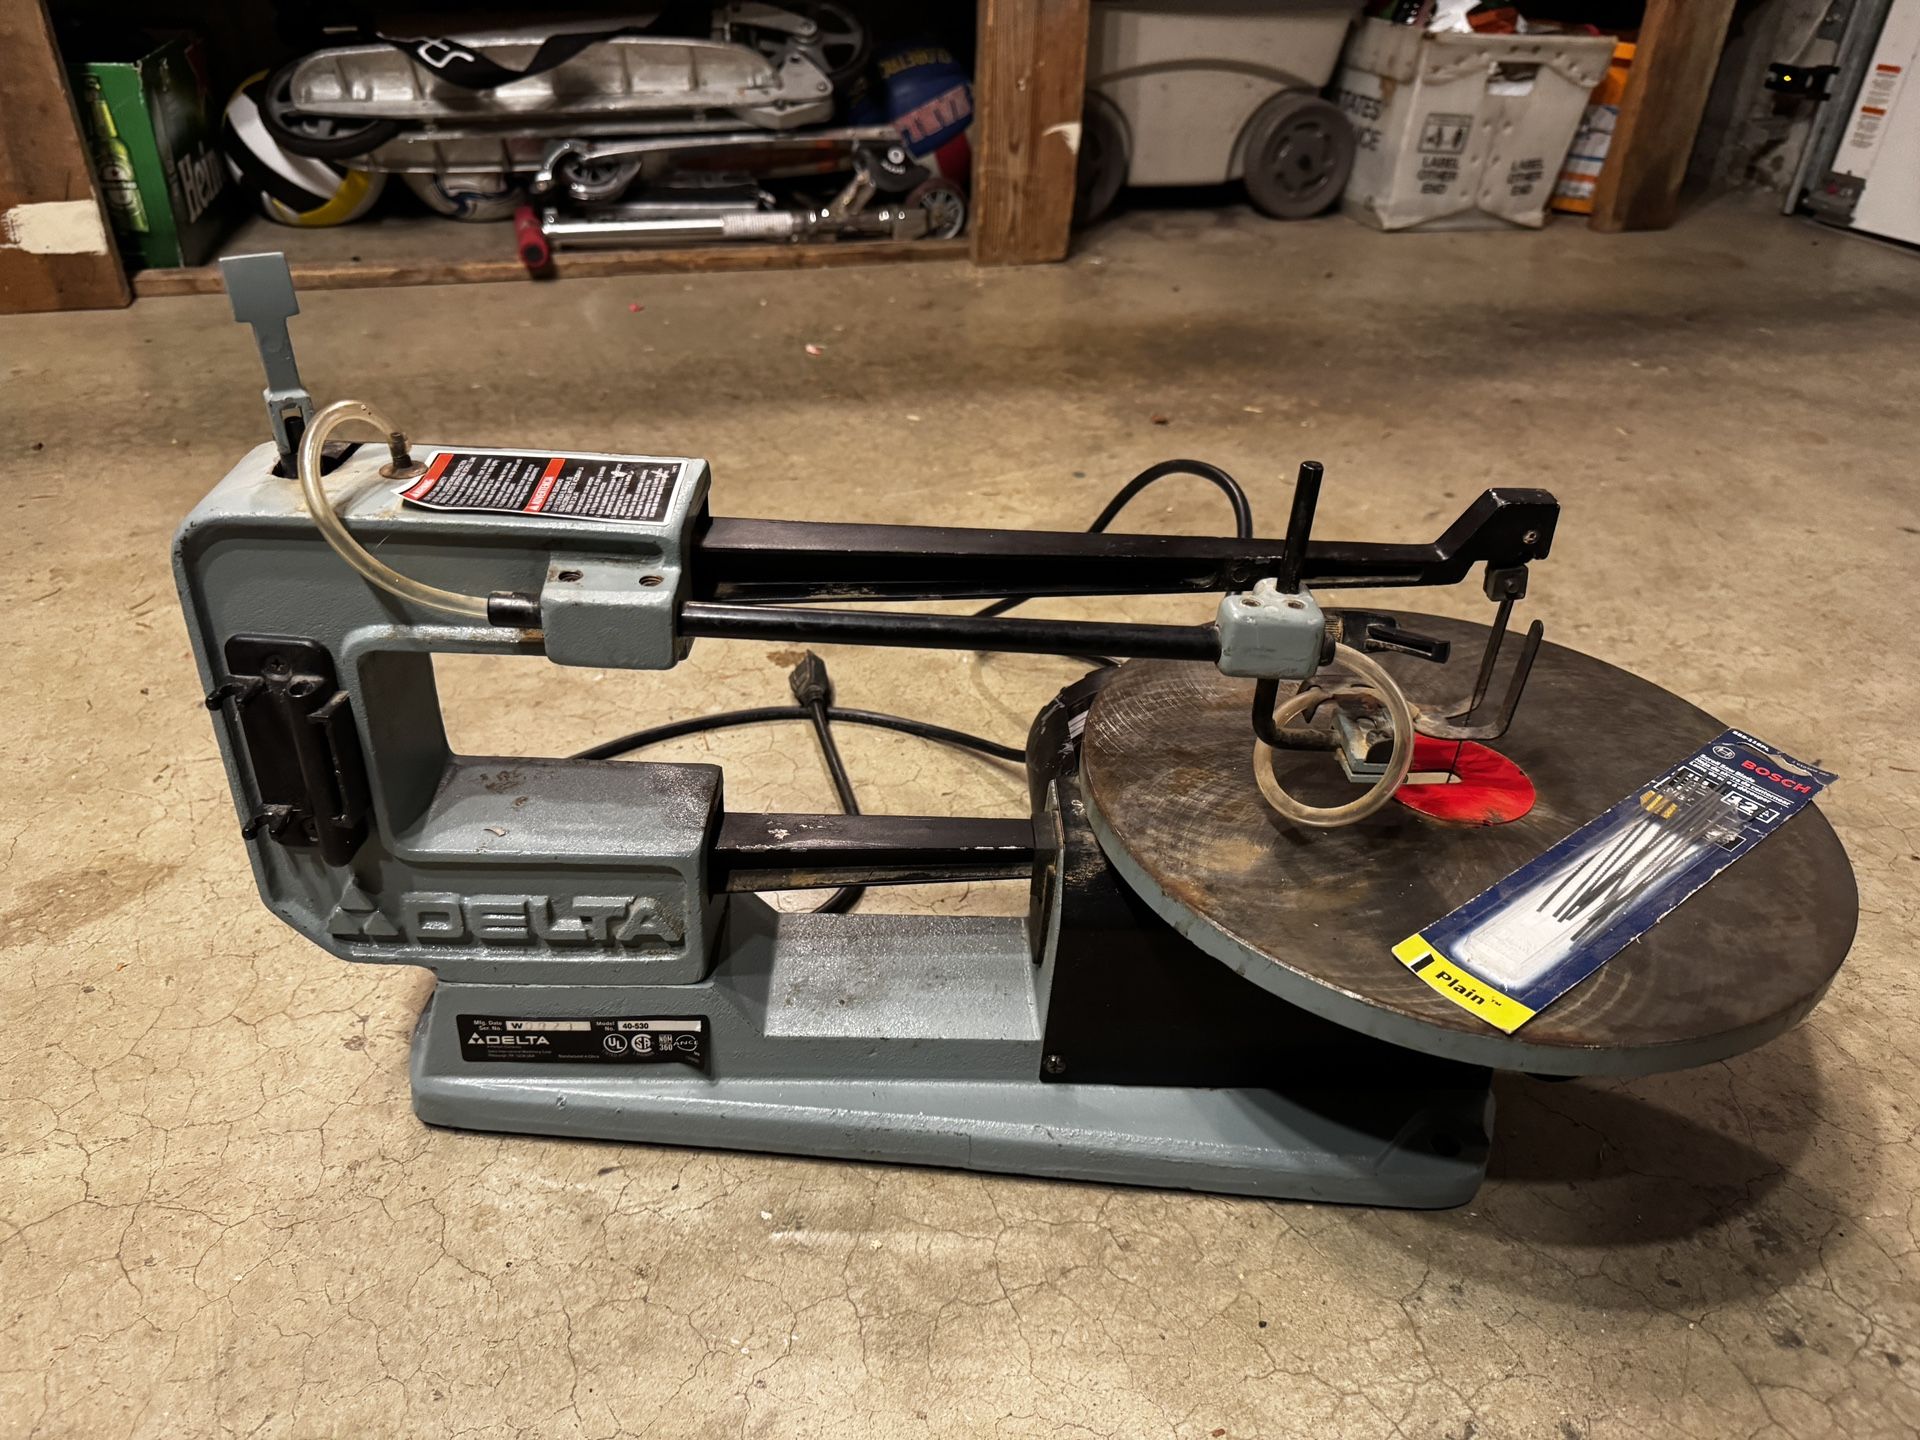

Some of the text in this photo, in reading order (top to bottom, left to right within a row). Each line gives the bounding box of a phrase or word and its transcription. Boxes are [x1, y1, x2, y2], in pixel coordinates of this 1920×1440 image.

[1700, 753, 1756, 784] Scroll Saw Blade
[1741, 759, 1812, 795] BOSCH
[1726, 794, 1759, 817] 12
[401, 891, 684, 942] DELTA
[1435, 970, 1485, 1005] Plain
[511, 1022, 523, 1030] W
[622, 1022, 649, 1030] 40-530
[486, 1035, 550, 1045] DELTA
